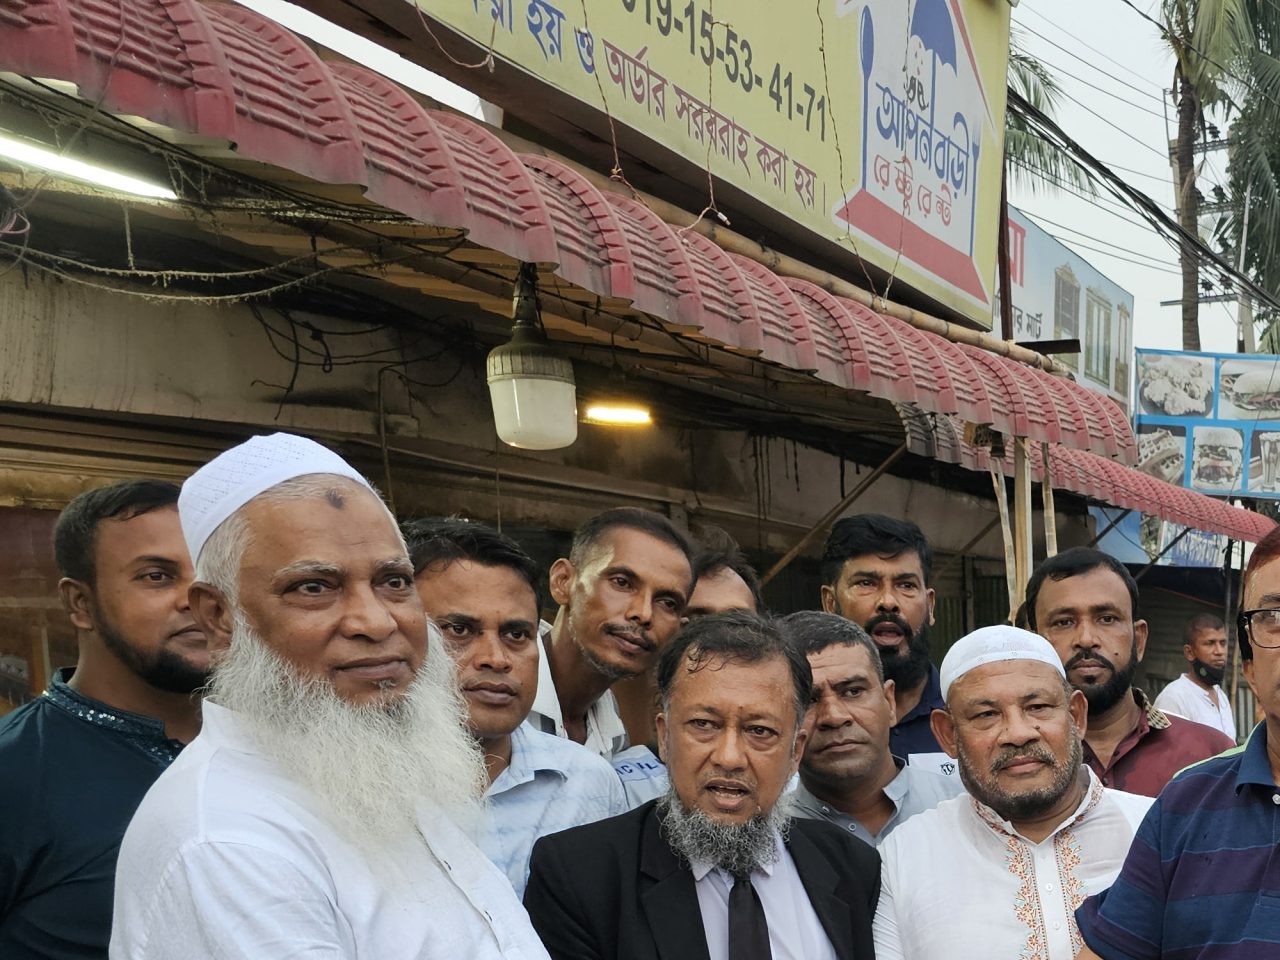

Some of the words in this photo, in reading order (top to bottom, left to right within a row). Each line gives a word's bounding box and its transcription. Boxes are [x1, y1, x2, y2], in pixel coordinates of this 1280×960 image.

[525, 0, 567, 62] হয়
[601, 37, 669, 123] অর্ডার
[672, 83, 752, 179] সরবরাহ
[754, 135, 789, 195] করা
